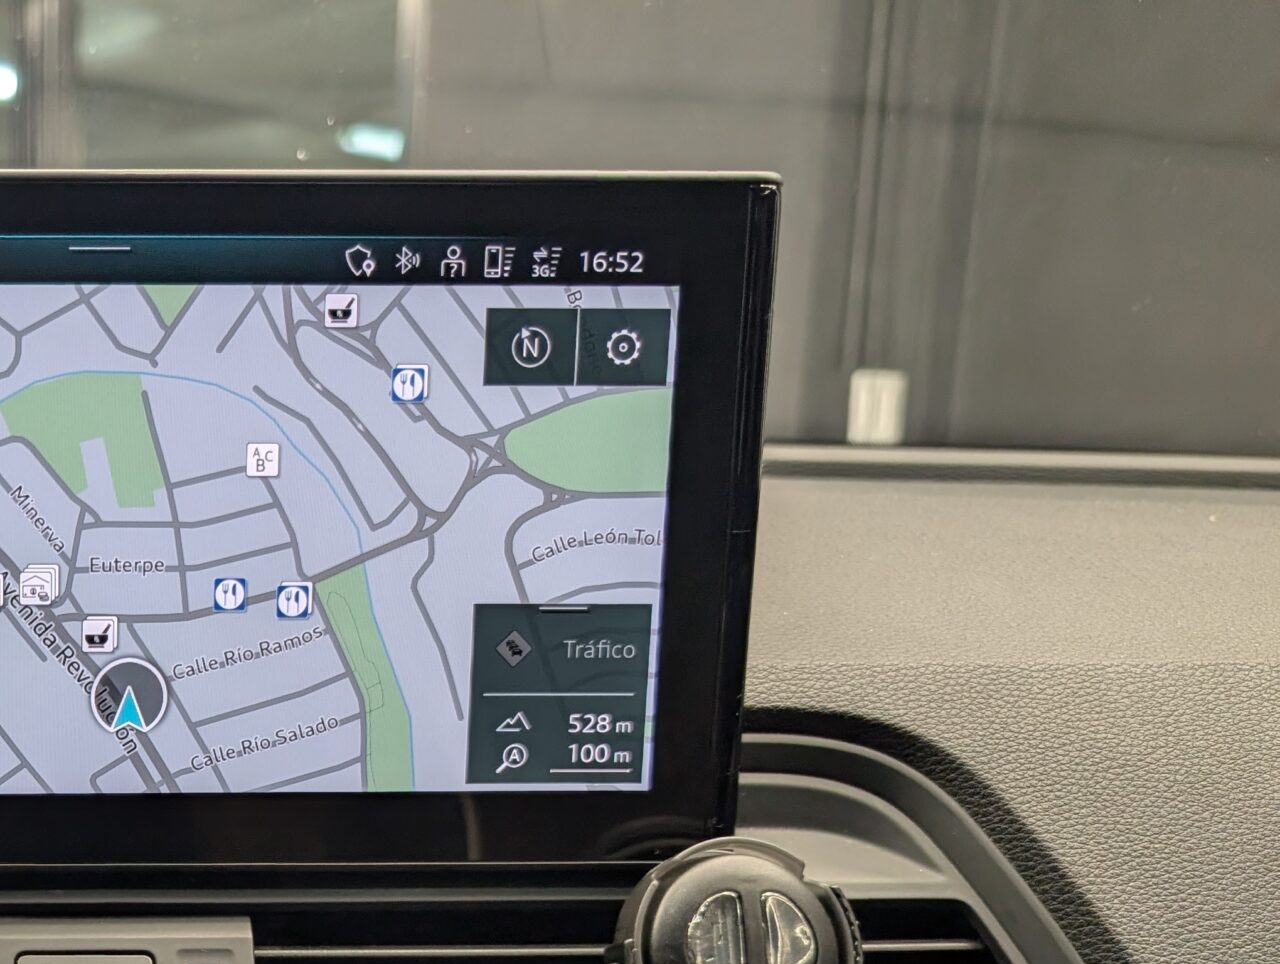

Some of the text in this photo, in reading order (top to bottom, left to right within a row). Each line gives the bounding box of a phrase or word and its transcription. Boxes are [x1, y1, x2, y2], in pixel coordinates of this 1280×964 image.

[531, 265, 550, 278] 3G
[579, 251, 644, 273] 16:52
[10, 485, 65, 553] Minerva
[531, 536, 578, 562] Calle
[583, 527, 628, 546] León
[89, 557, 166, 574] Euterpe
[172, 625, 323, 680] Calle Río Ramos
[563, 638, 636, 659] Tráfico
[55, 645, 138, 755] Revolucón
[568, 713, 634, 734] 528 m
[190, 716, 339, 771] Calle Río Salado
[568, 743, 632, 763] 100 m
